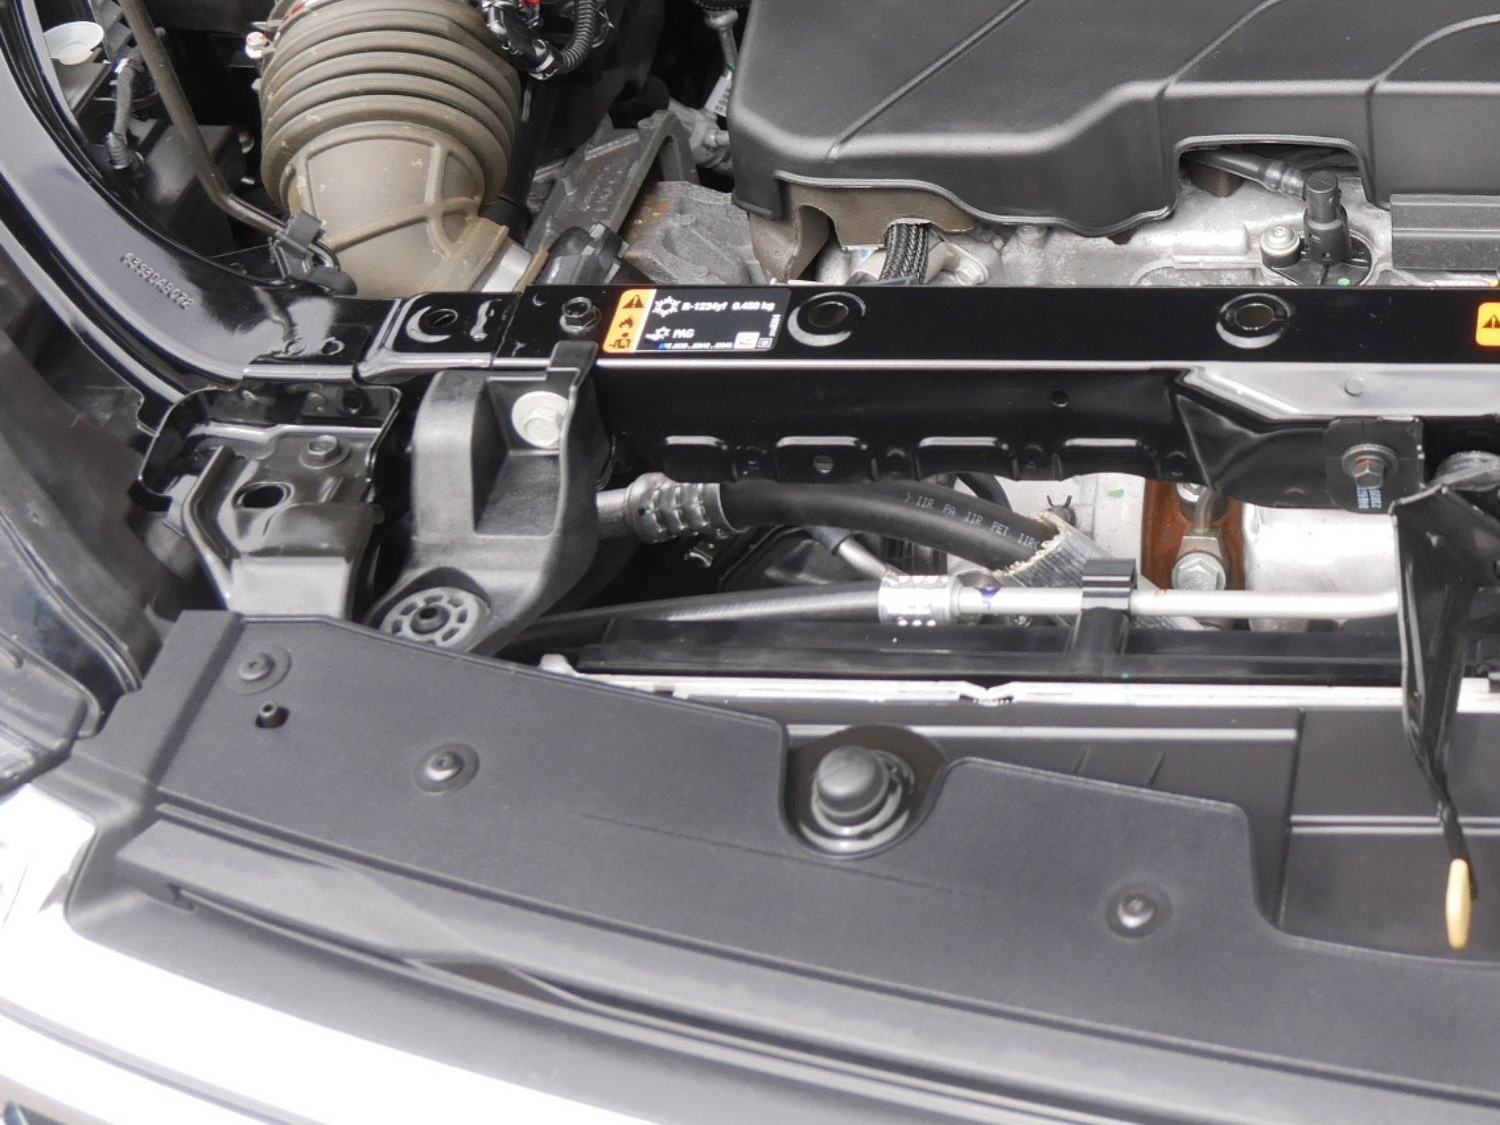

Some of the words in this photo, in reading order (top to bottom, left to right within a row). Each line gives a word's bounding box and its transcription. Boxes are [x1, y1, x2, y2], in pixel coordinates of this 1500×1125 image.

[672, 328, 695, 339] PAG
[916, 495, 935, 510] IIR
[942, 504, 956, 517] PA
[964, 511, 984, 527] IIR
[990, 521, 1010, 537] PET
